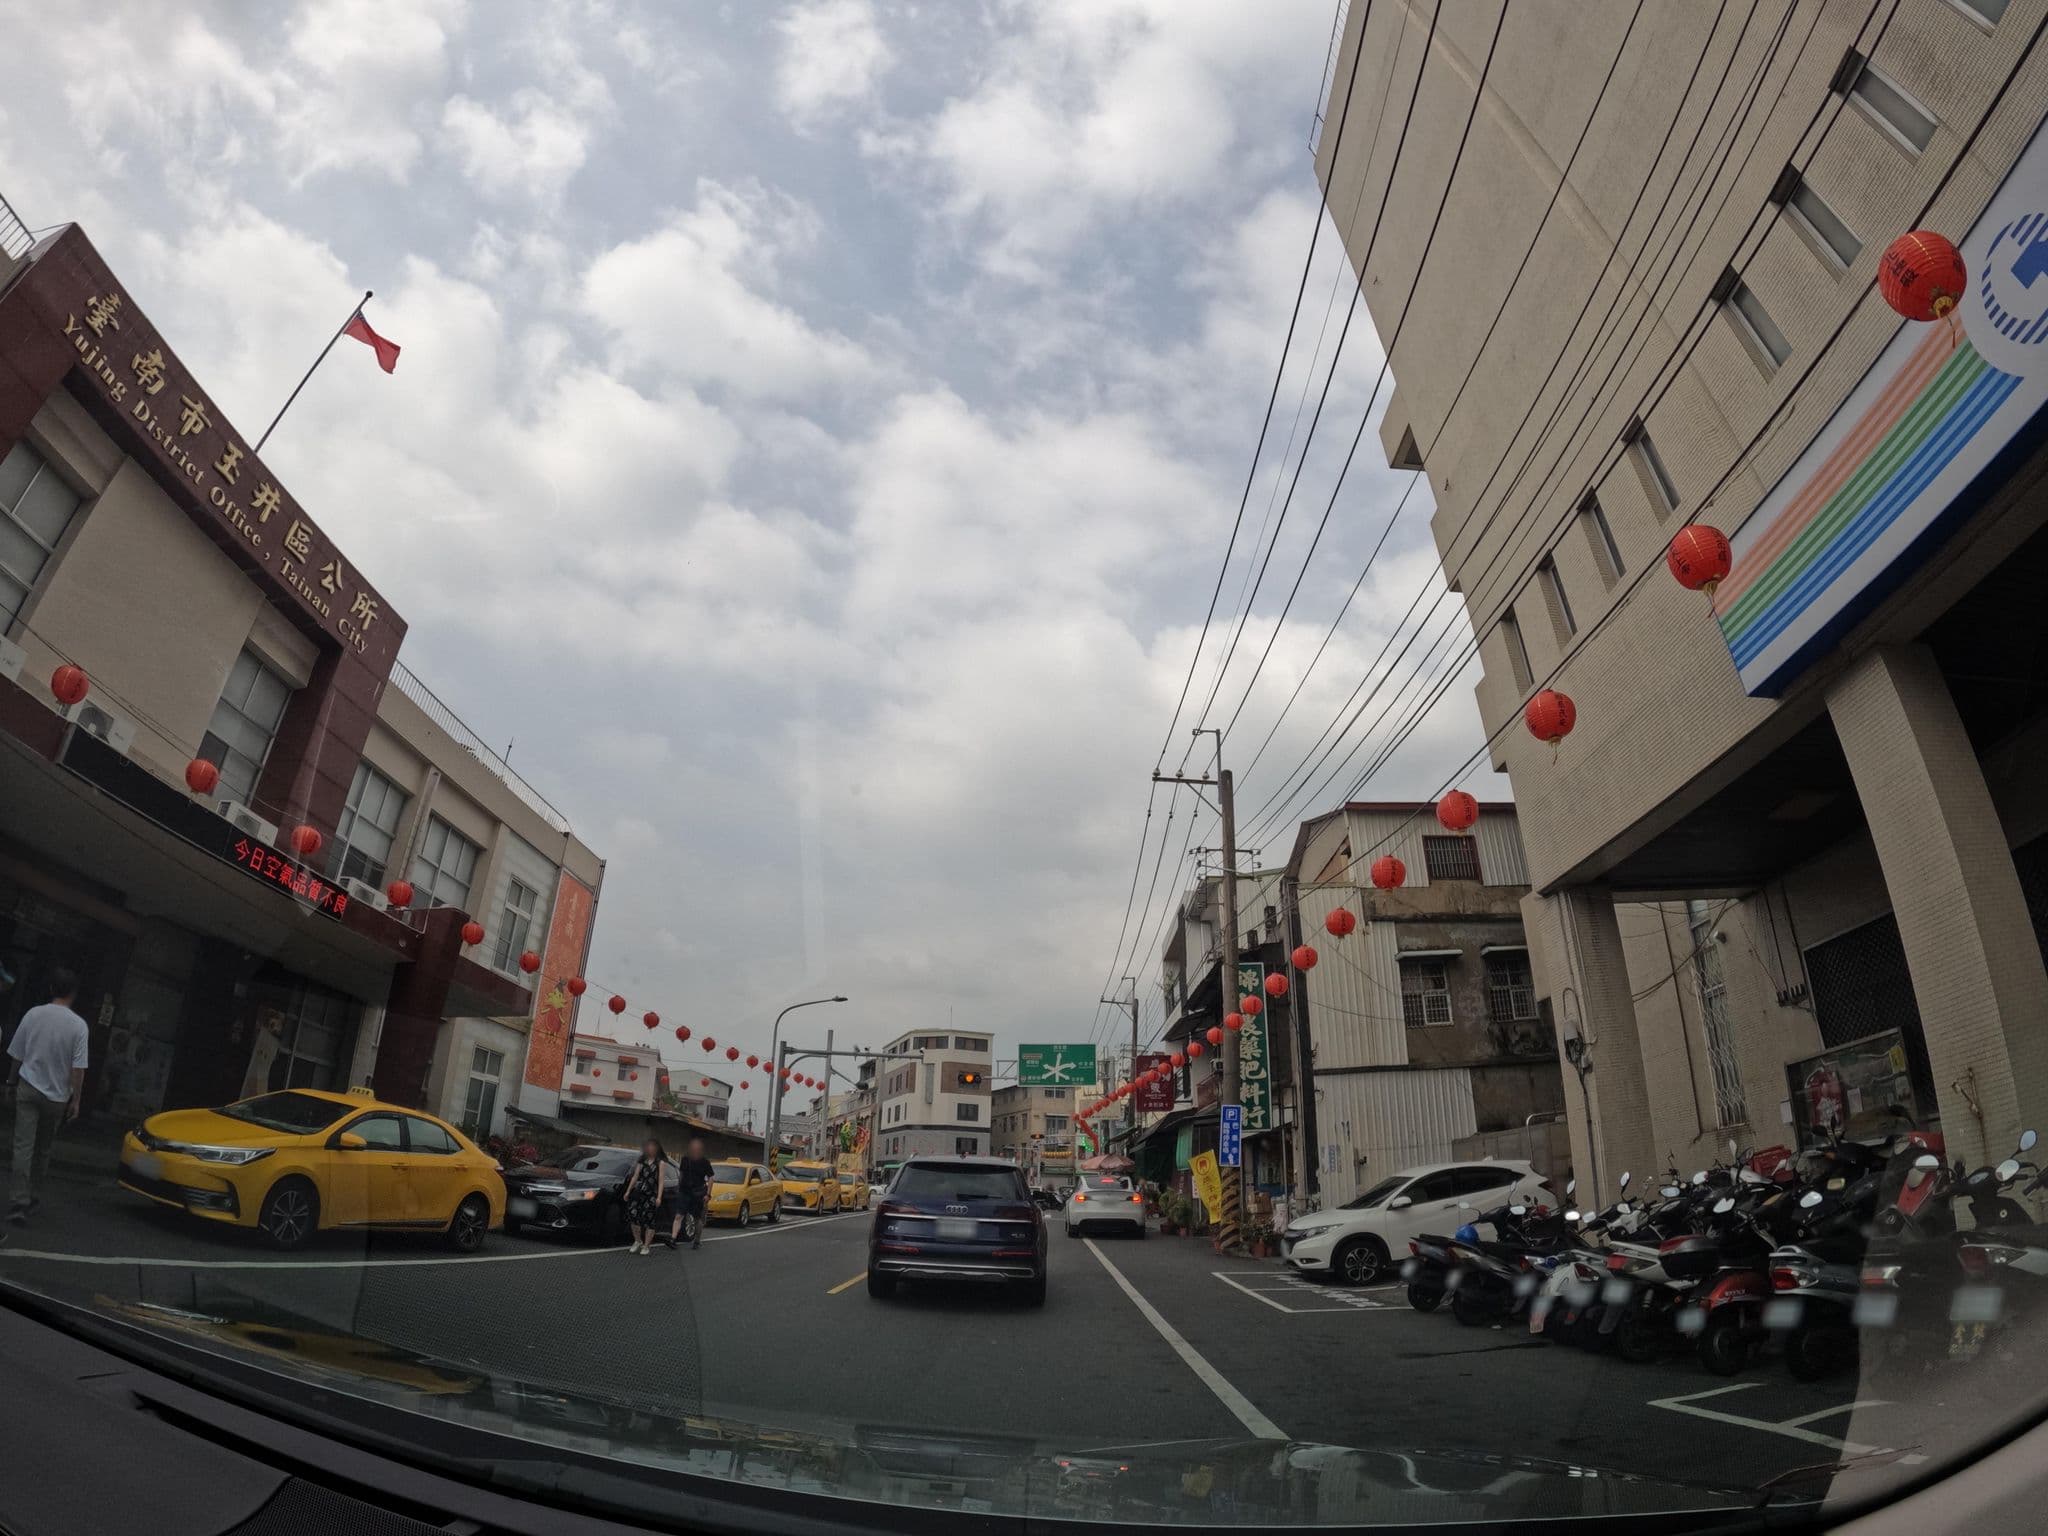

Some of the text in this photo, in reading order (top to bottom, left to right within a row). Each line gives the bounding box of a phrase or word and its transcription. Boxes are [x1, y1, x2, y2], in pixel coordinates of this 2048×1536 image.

[61, 312, 128, 403] Yujing
[131, 399, 205, 486] District
[280, 556, 331, 620] Tainan
[337, 617, 369, 655] City
[84, 292, 379, 632] 臺南市玉井區公所
[233, 838, 349, 914] 今日空氣品質不良
